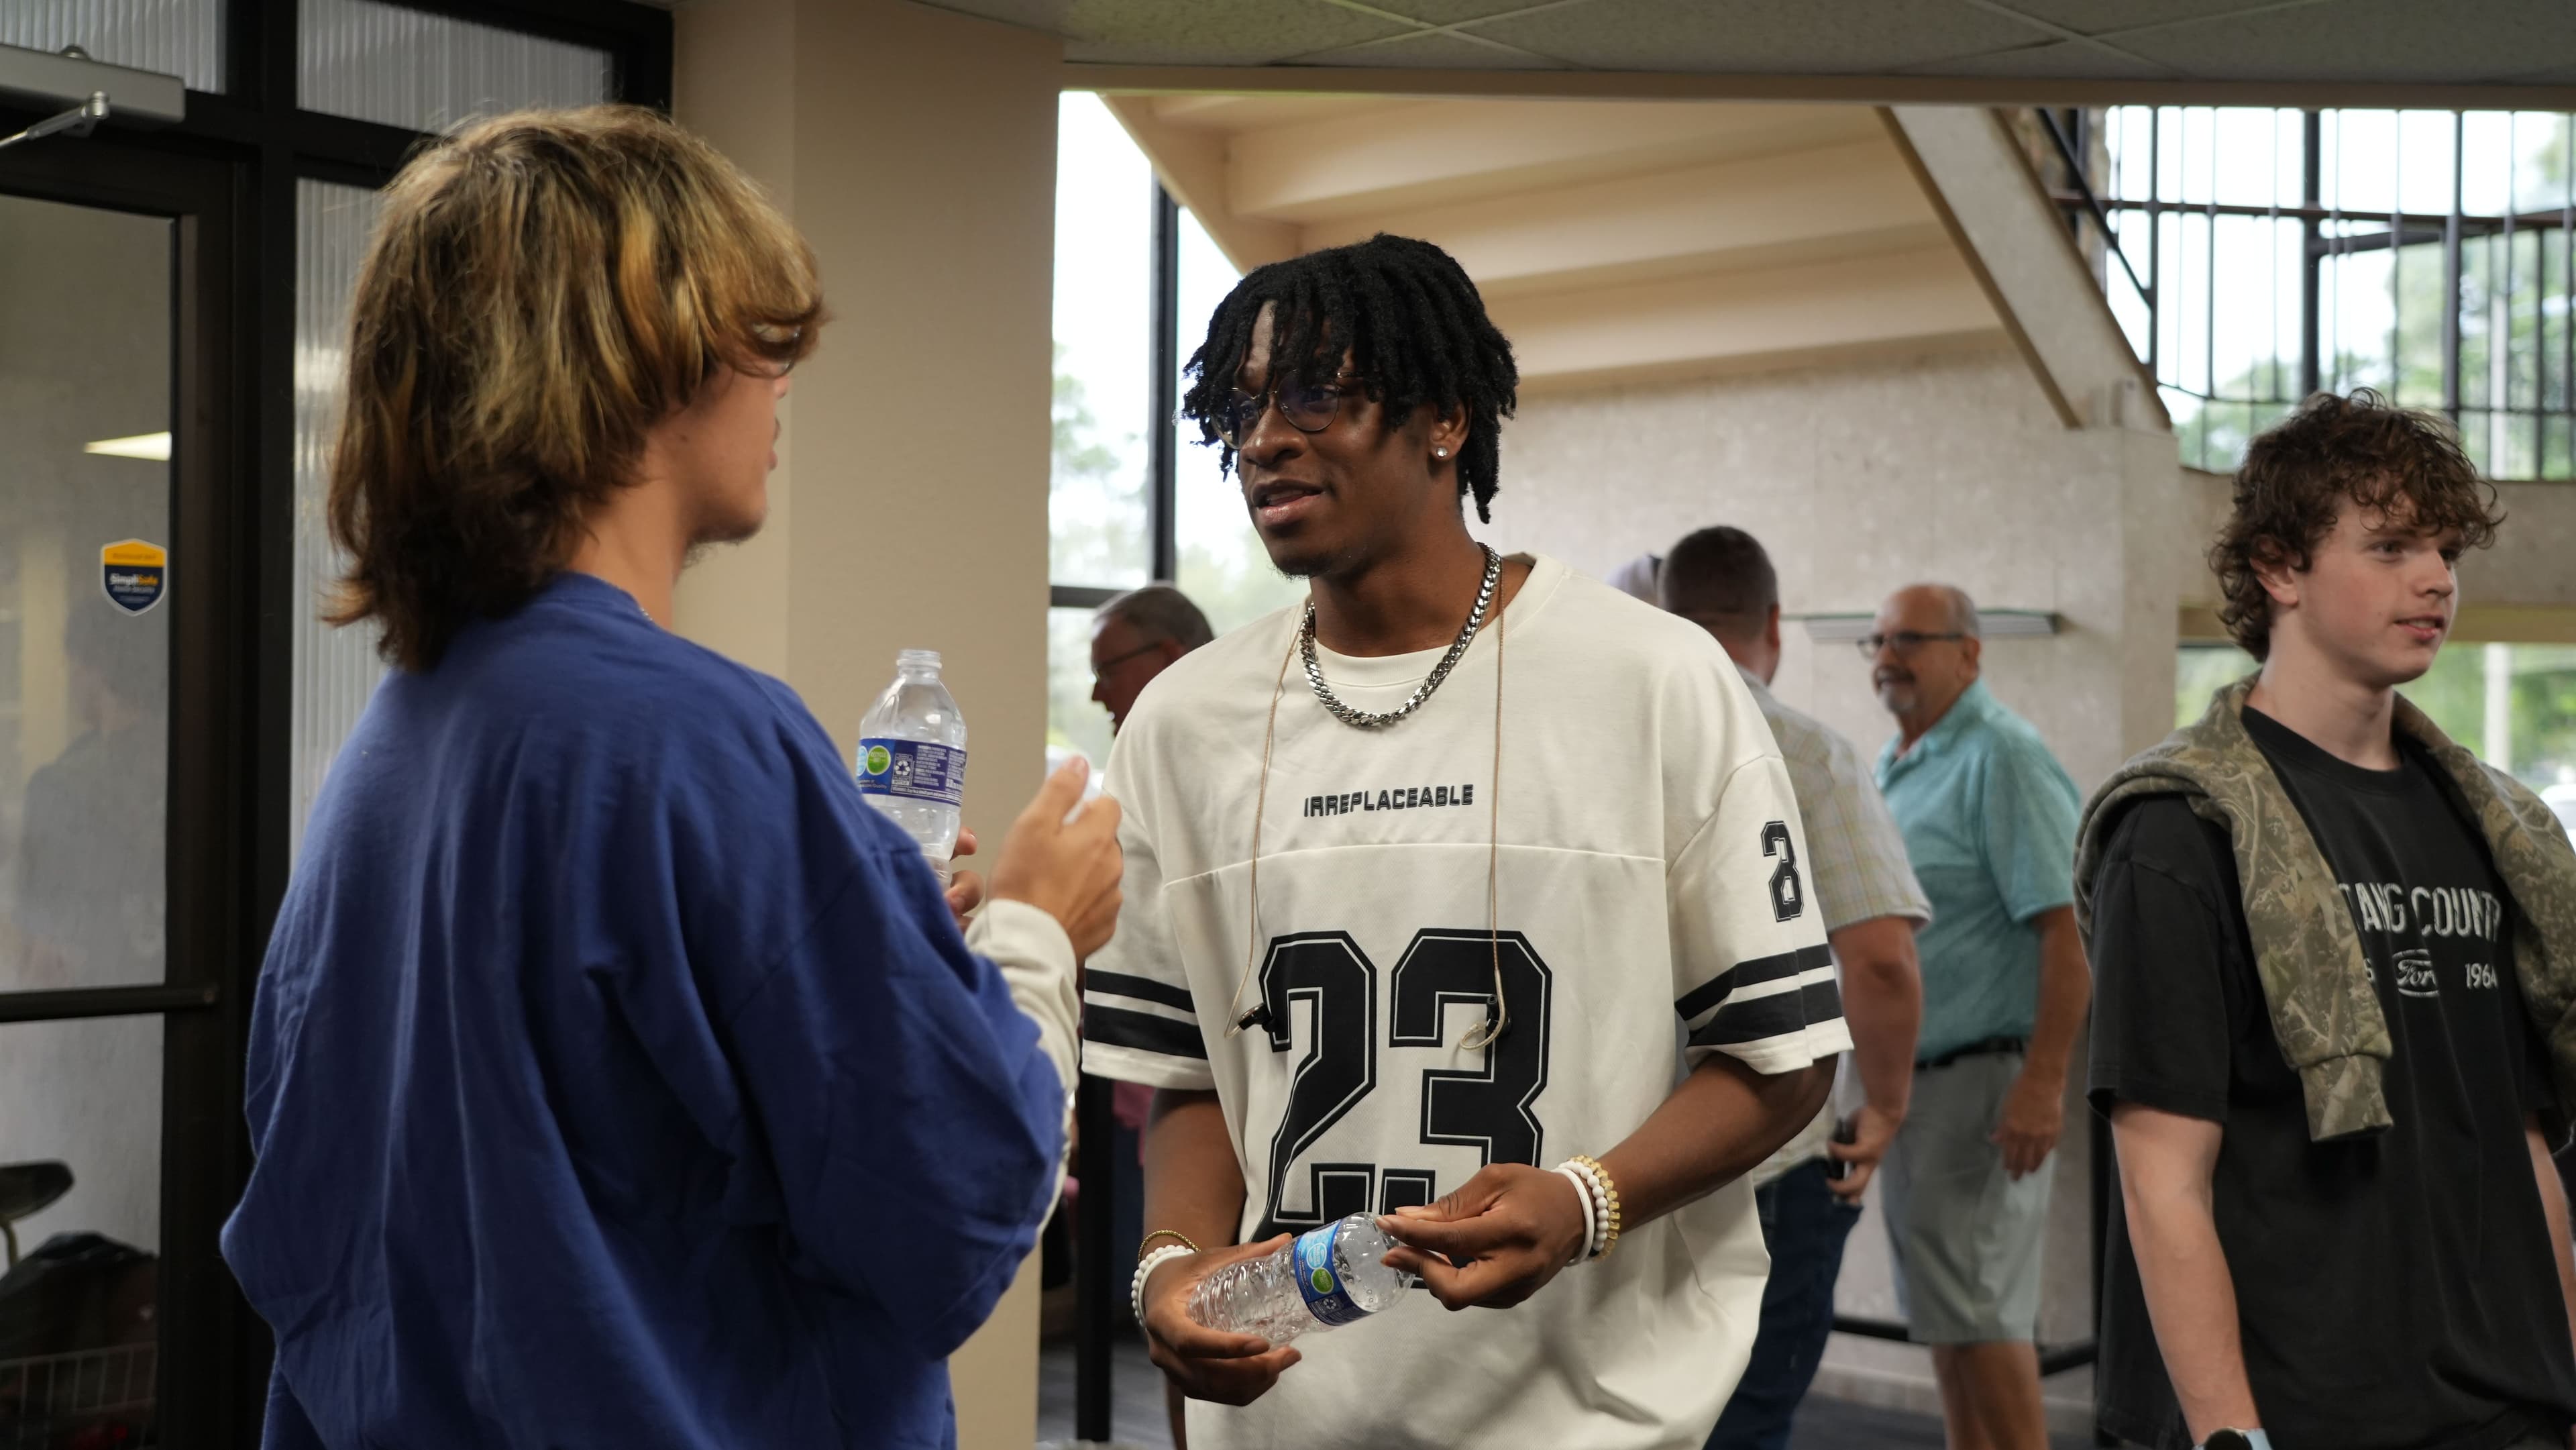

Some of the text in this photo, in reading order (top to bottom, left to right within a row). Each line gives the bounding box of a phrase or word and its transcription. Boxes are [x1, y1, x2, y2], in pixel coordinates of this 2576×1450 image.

[1303, 784, 1474, 817] IRREPLACEABLE
[2465, 962, 2500, 990] 1964
[1249, 928, 1552, 1288] 23
